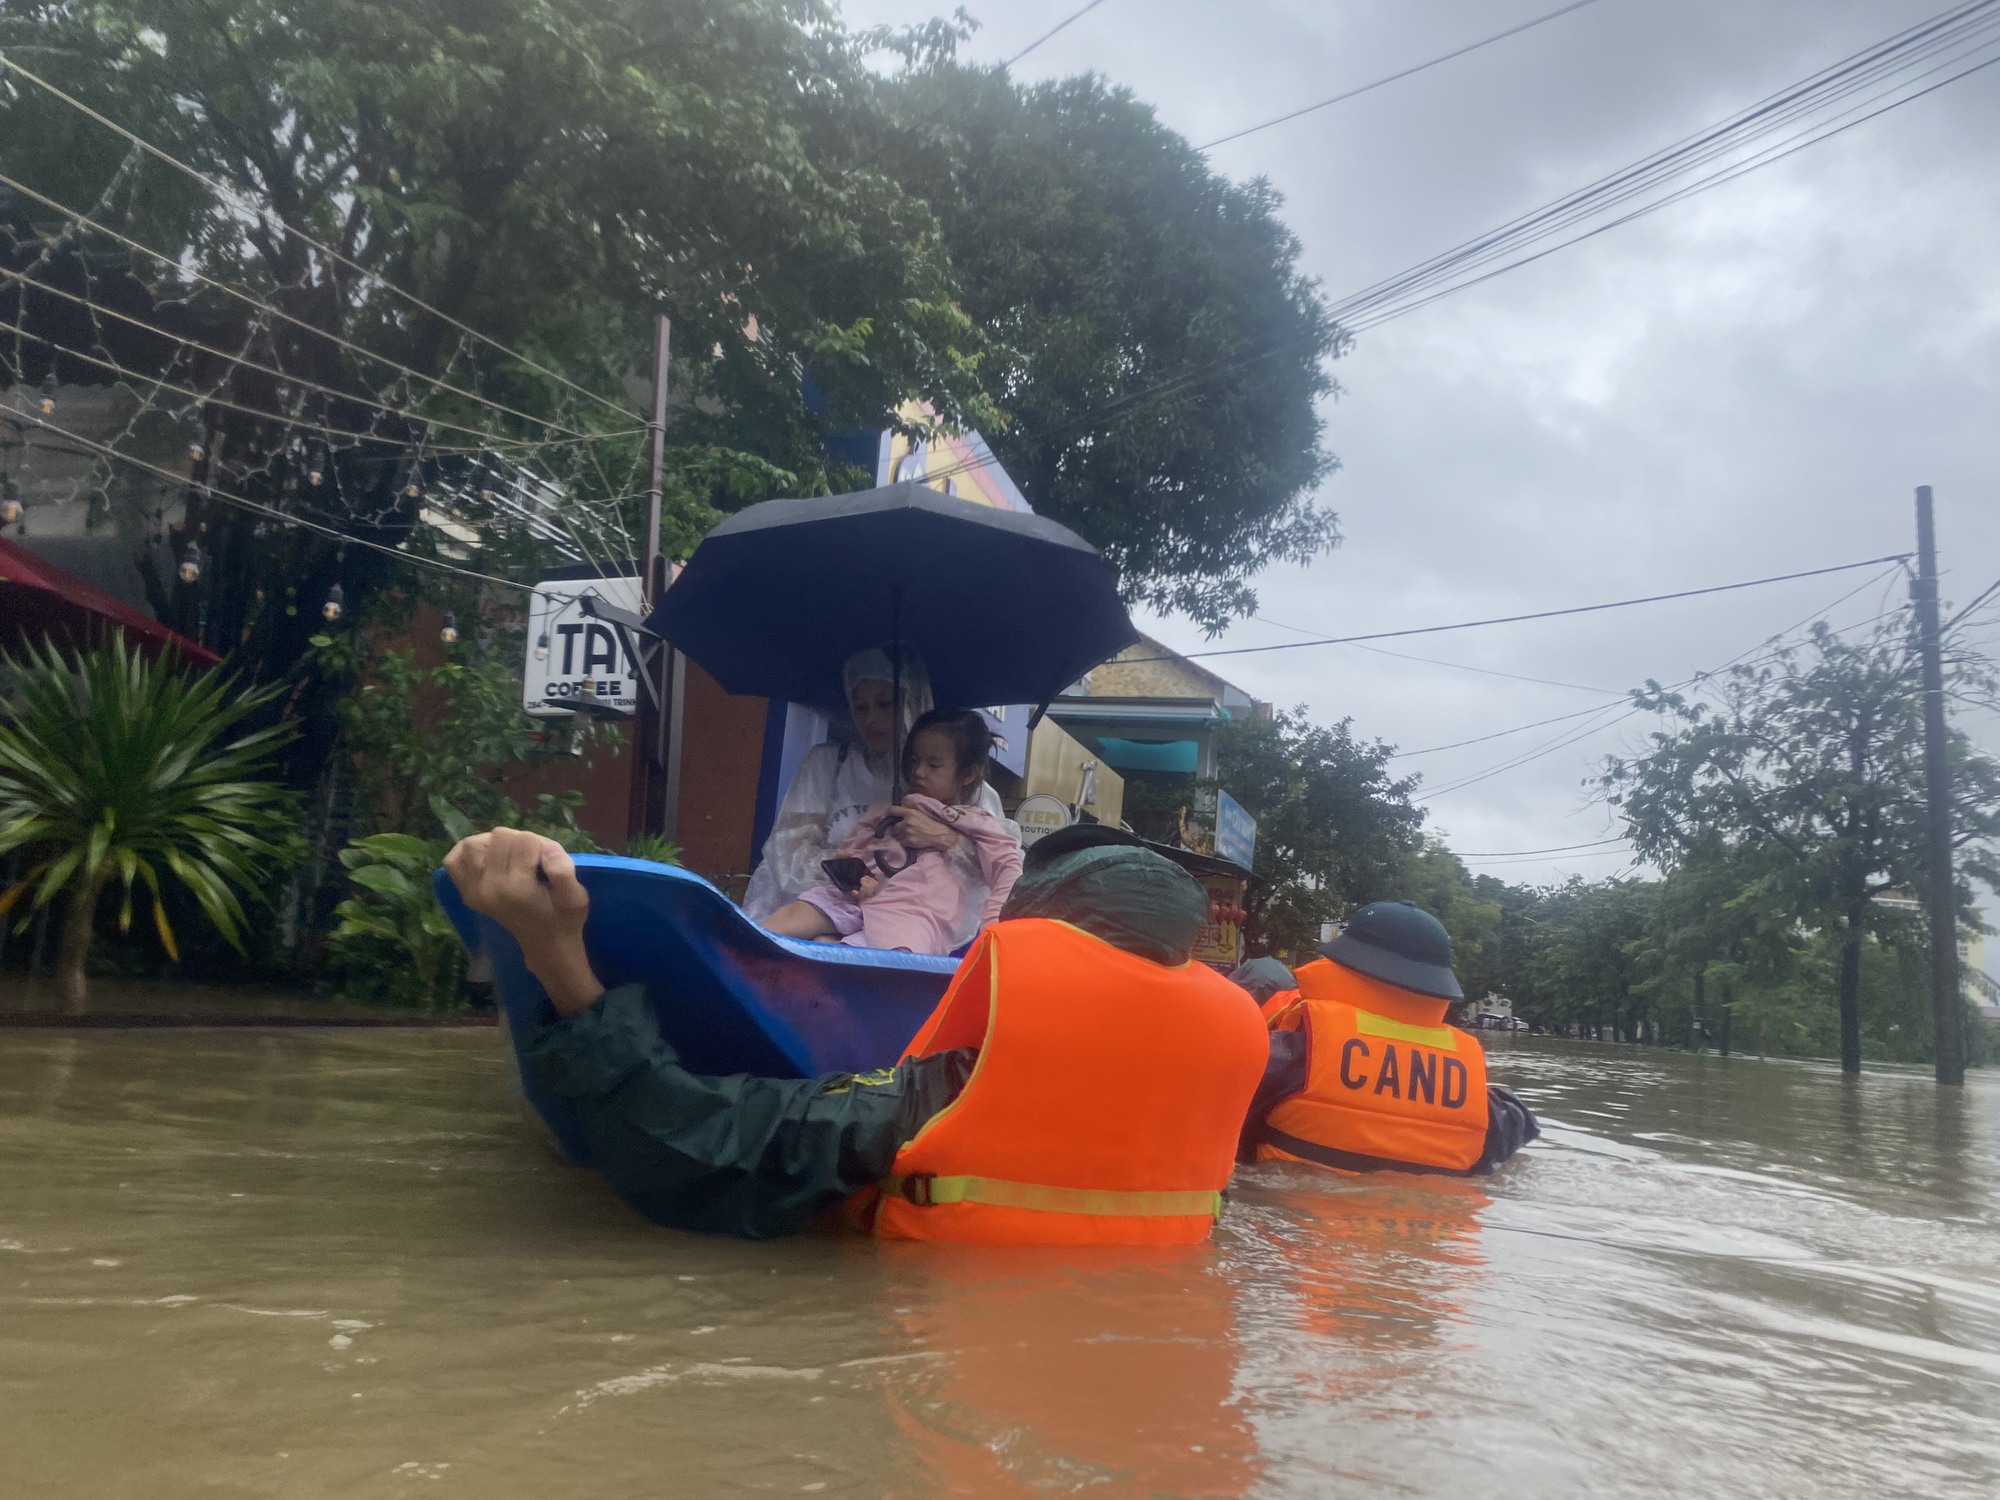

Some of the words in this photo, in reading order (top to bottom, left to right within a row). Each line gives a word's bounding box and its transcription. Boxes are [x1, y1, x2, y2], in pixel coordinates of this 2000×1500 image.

[556, 623, 617, 675] TA
[545, 680, 622, 698] COFEE
[1023, 810, 1061, 825] TEM
[1340, 1038, 1467, 1109] CAND
